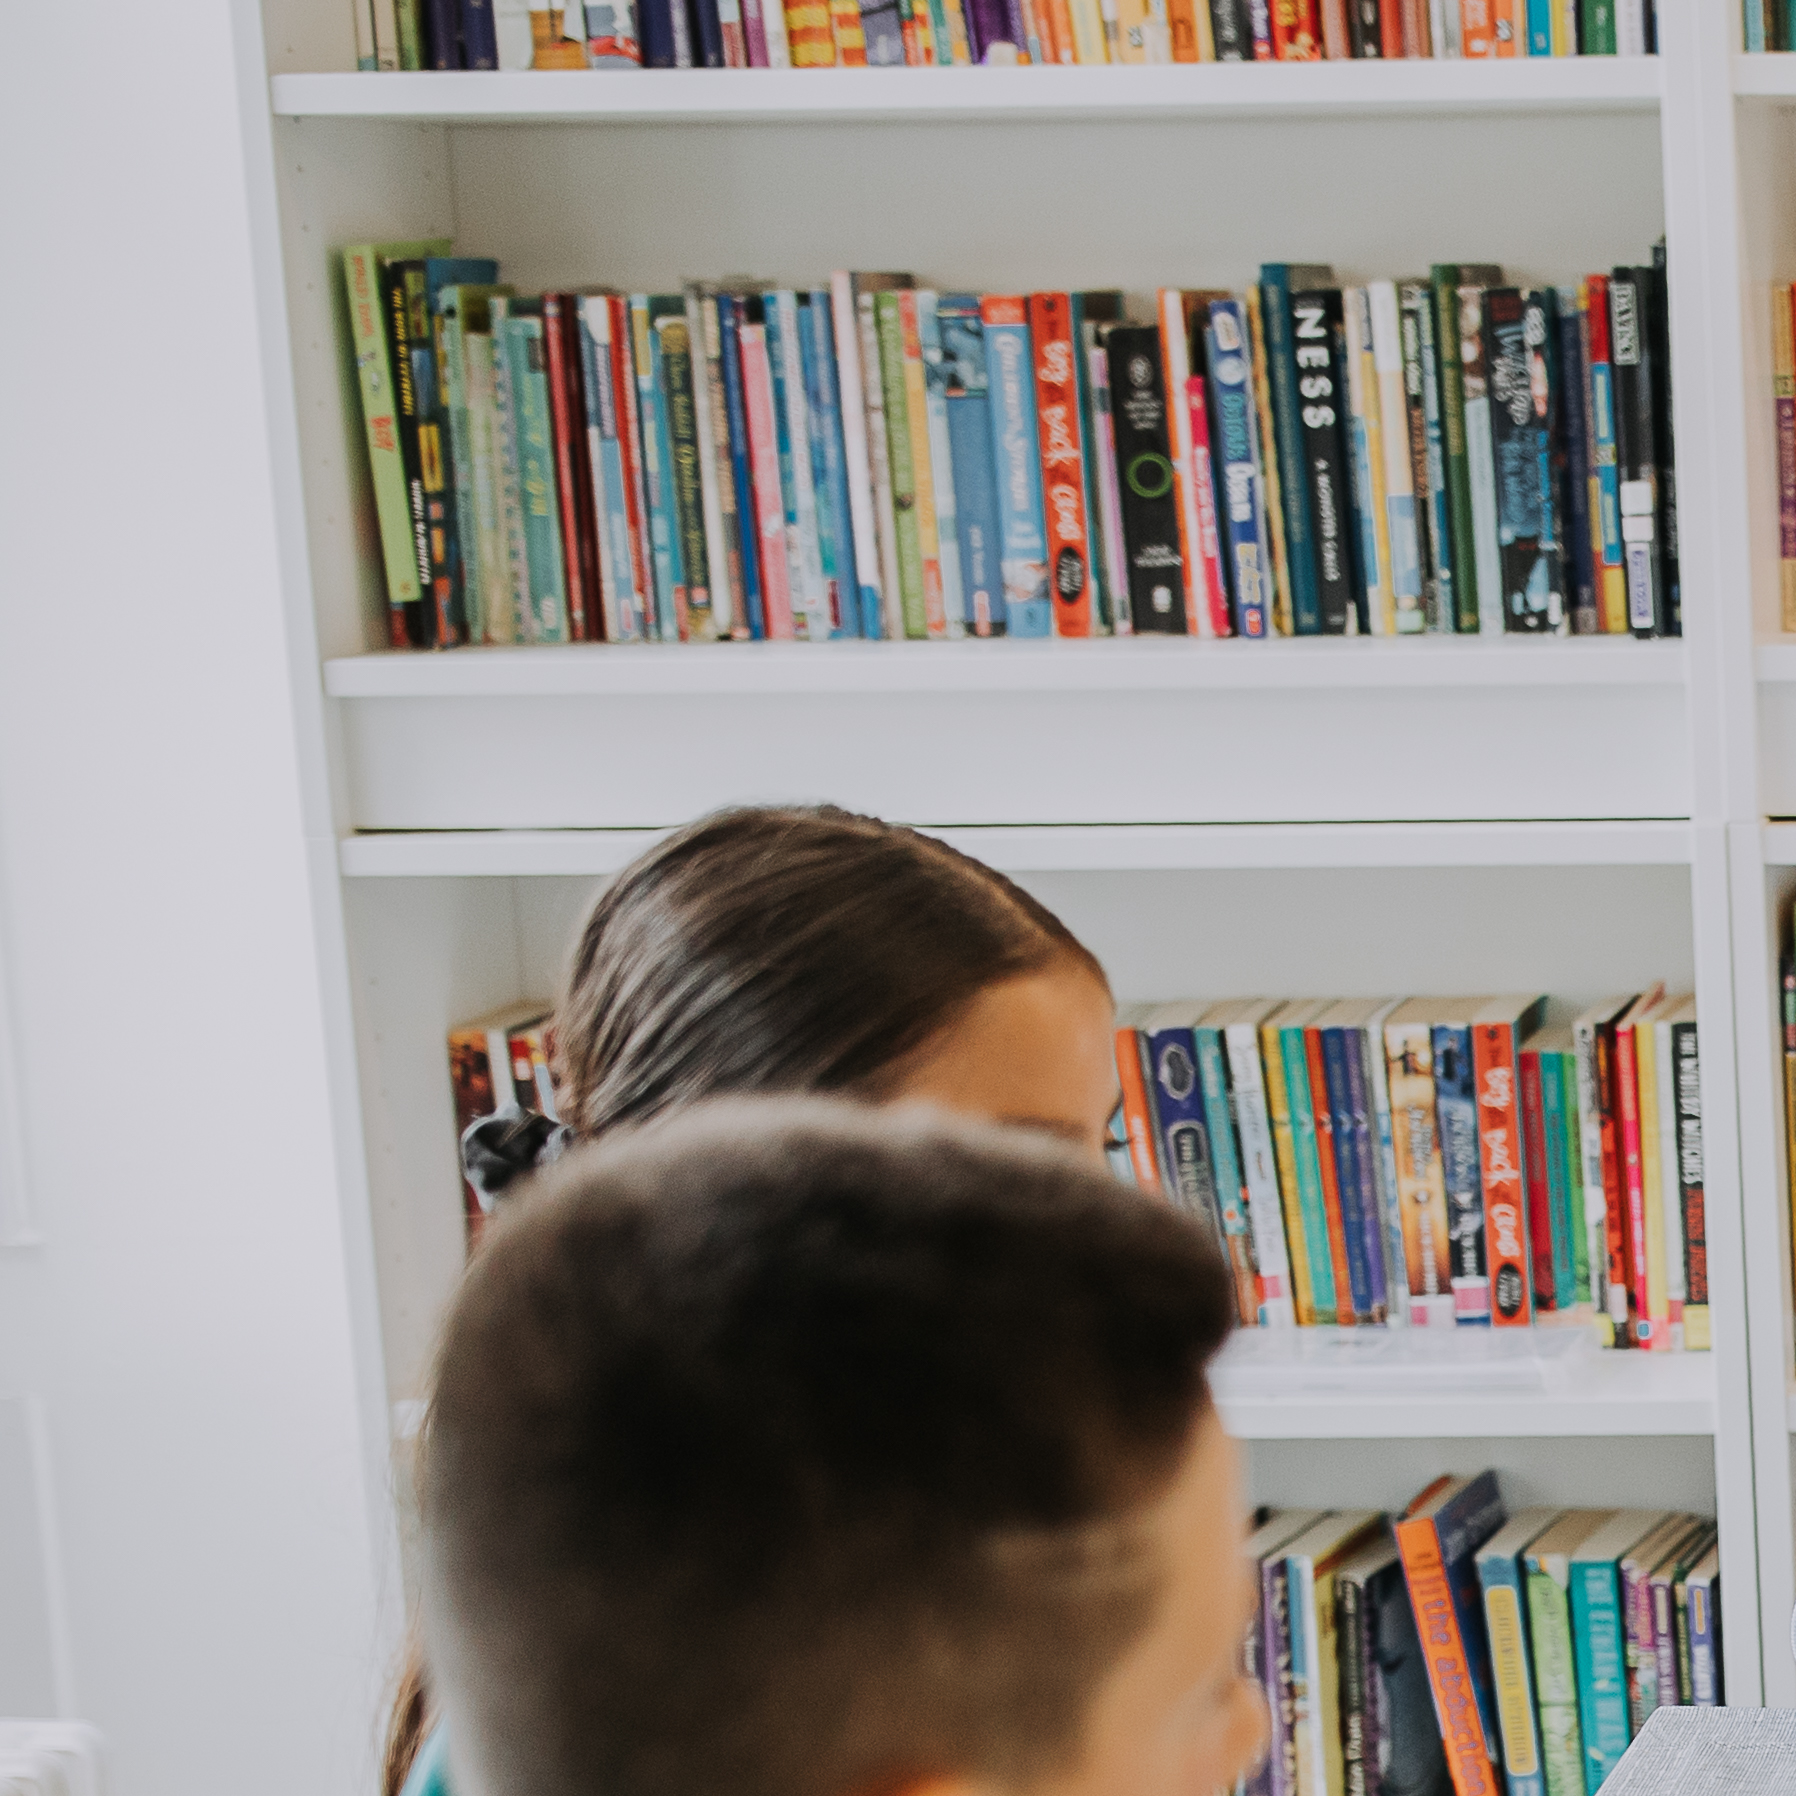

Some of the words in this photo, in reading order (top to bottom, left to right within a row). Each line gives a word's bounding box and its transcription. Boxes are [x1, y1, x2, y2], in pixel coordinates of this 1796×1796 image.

[1293, 307, 1336, 429] NESS
[1315, 475, 1337, 538] MONSTER
[1322, 541, 1339, 582] CALLS
[1423, 1598, 1456, 1645] the
